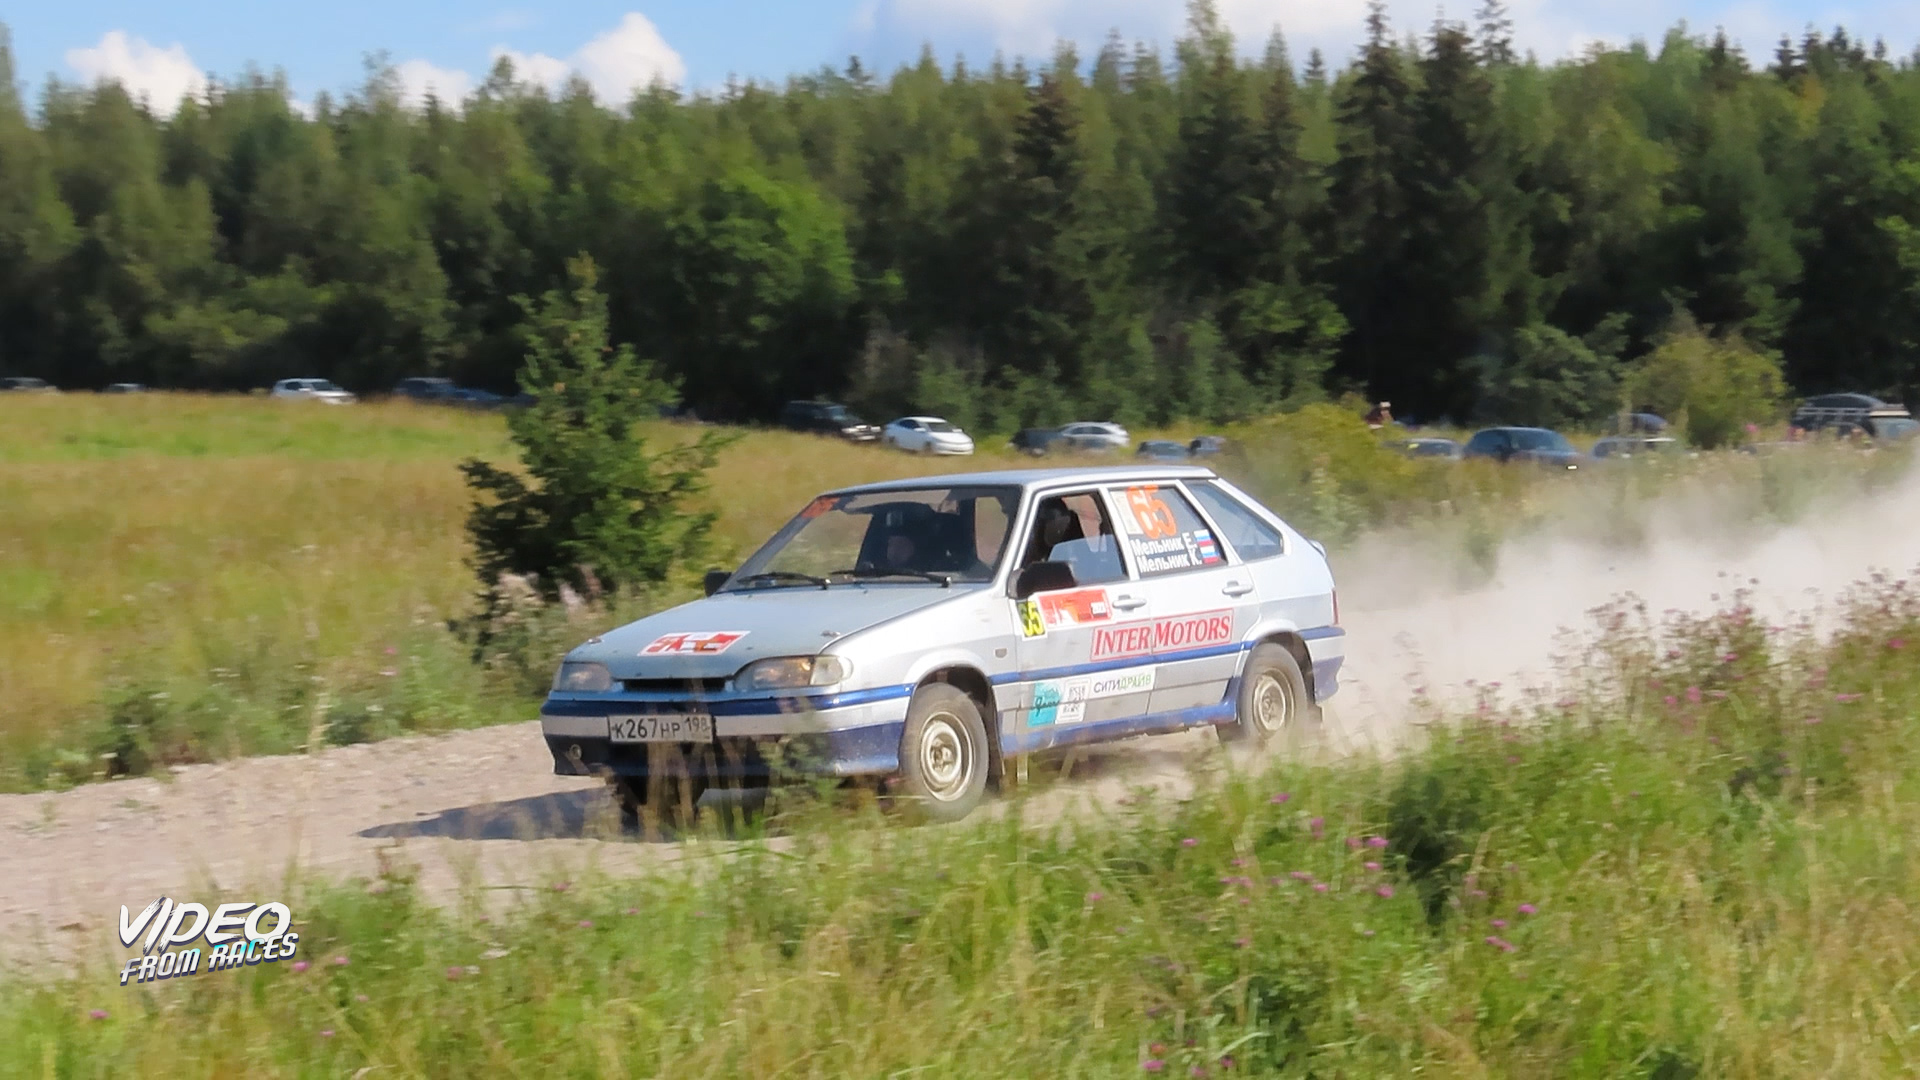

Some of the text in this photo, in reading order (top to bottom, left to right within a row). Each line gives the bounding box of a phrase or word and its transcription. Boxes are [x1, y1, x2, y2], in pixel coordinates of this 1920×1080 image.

[1126, 484, 1177, 539] 65
[1130, 537, 1185, 556] Мельник
[1136, 555, 1191, 573] Мельник
[1017, 601, 1045, 637] 65
